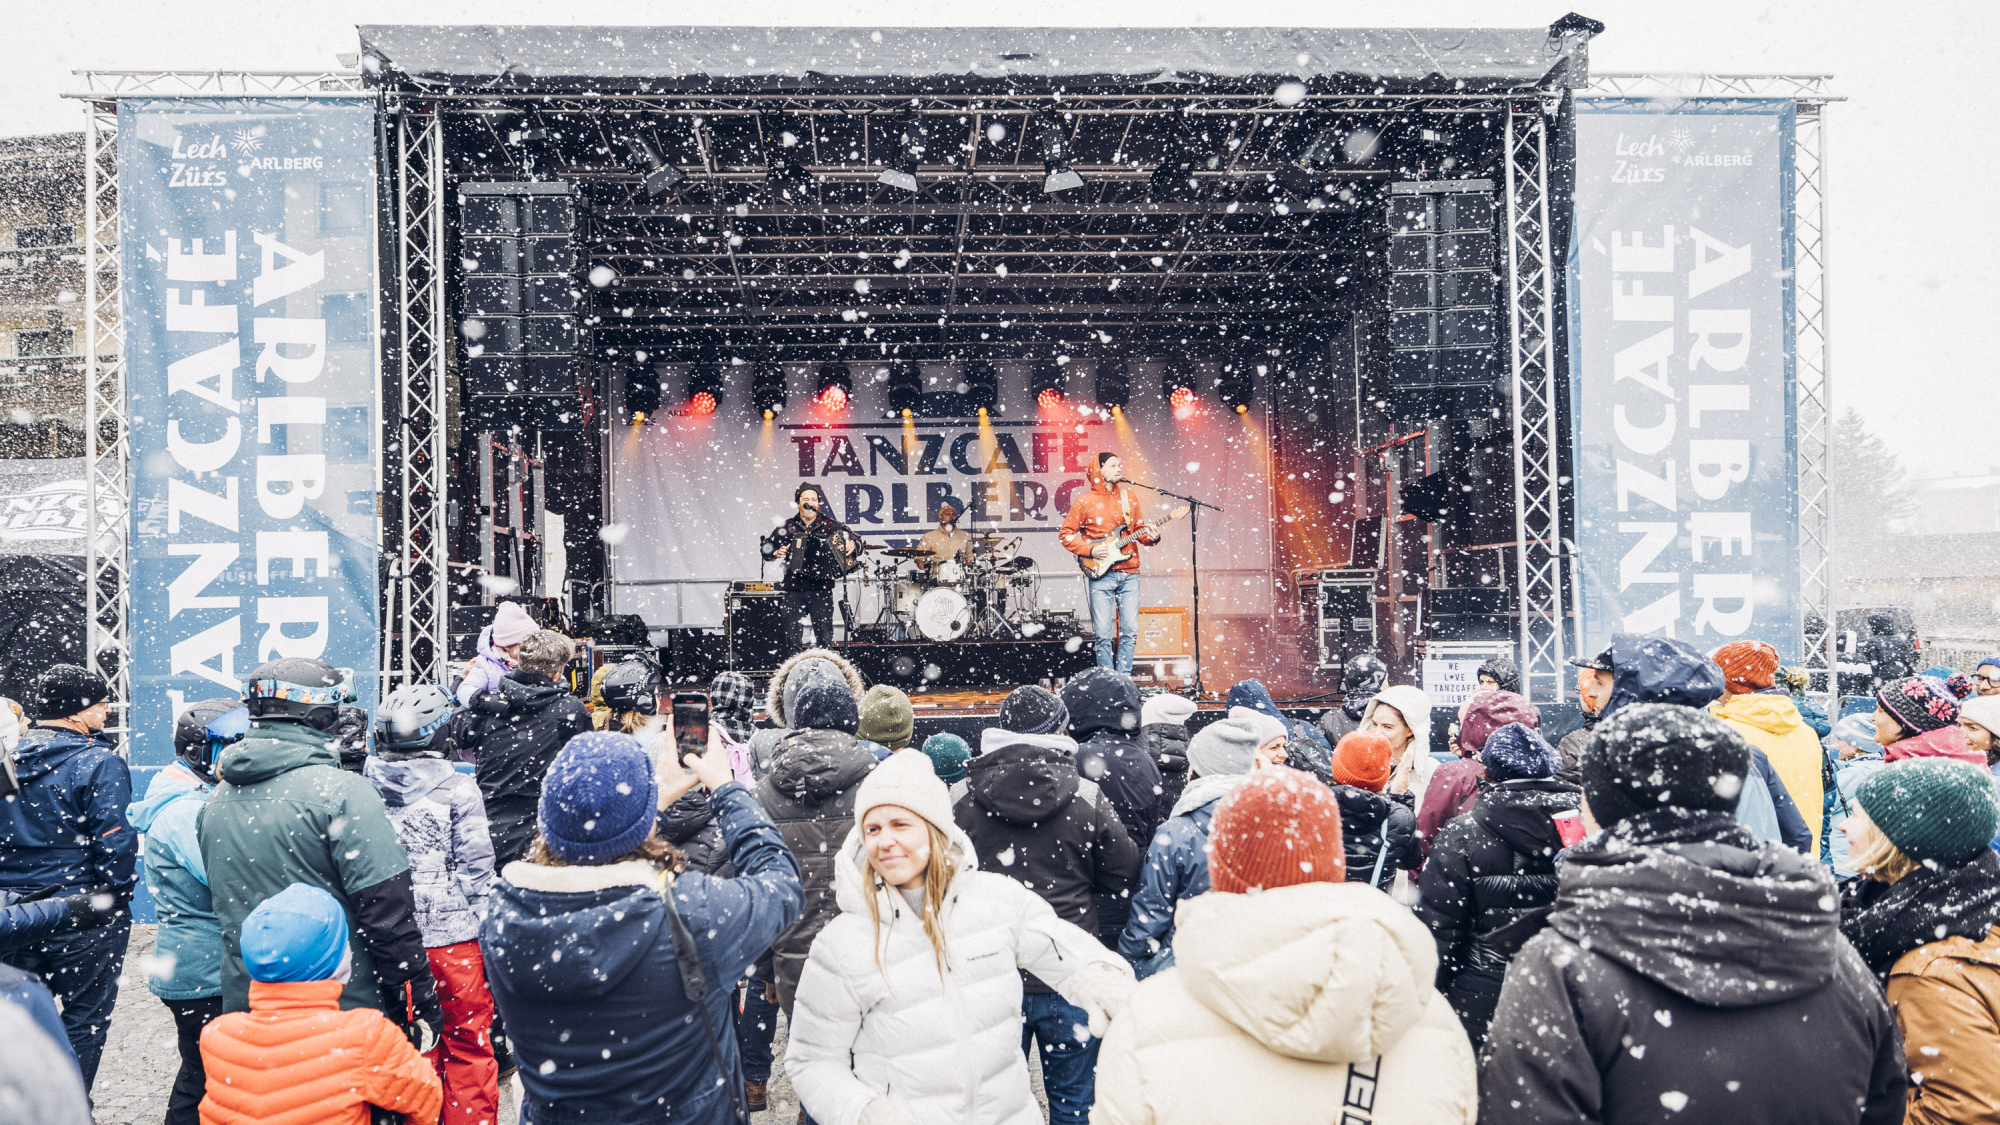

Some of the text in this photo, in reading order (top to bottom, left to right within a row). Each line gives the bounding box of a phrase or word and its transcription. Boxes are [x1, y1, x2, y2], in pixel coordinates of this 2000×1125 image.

[171, 135, 227, 159] Lech
[1615, 133, 1664, 156] Lech
[250, 156, 323, 171] ARLBERG
[1611, 158, 1666, 184] Zürs
[1684, 154, 1753, 167] ARLBERG
[168, 162, 227, 188] Zürs
[1593, 224, 1681, 640] ANZCAFÉ
[1688, 226, 1755, 657] ARLBER
[253, 231, 329, 662] ARLBER
[1448, 662, 1459, 671] WE
